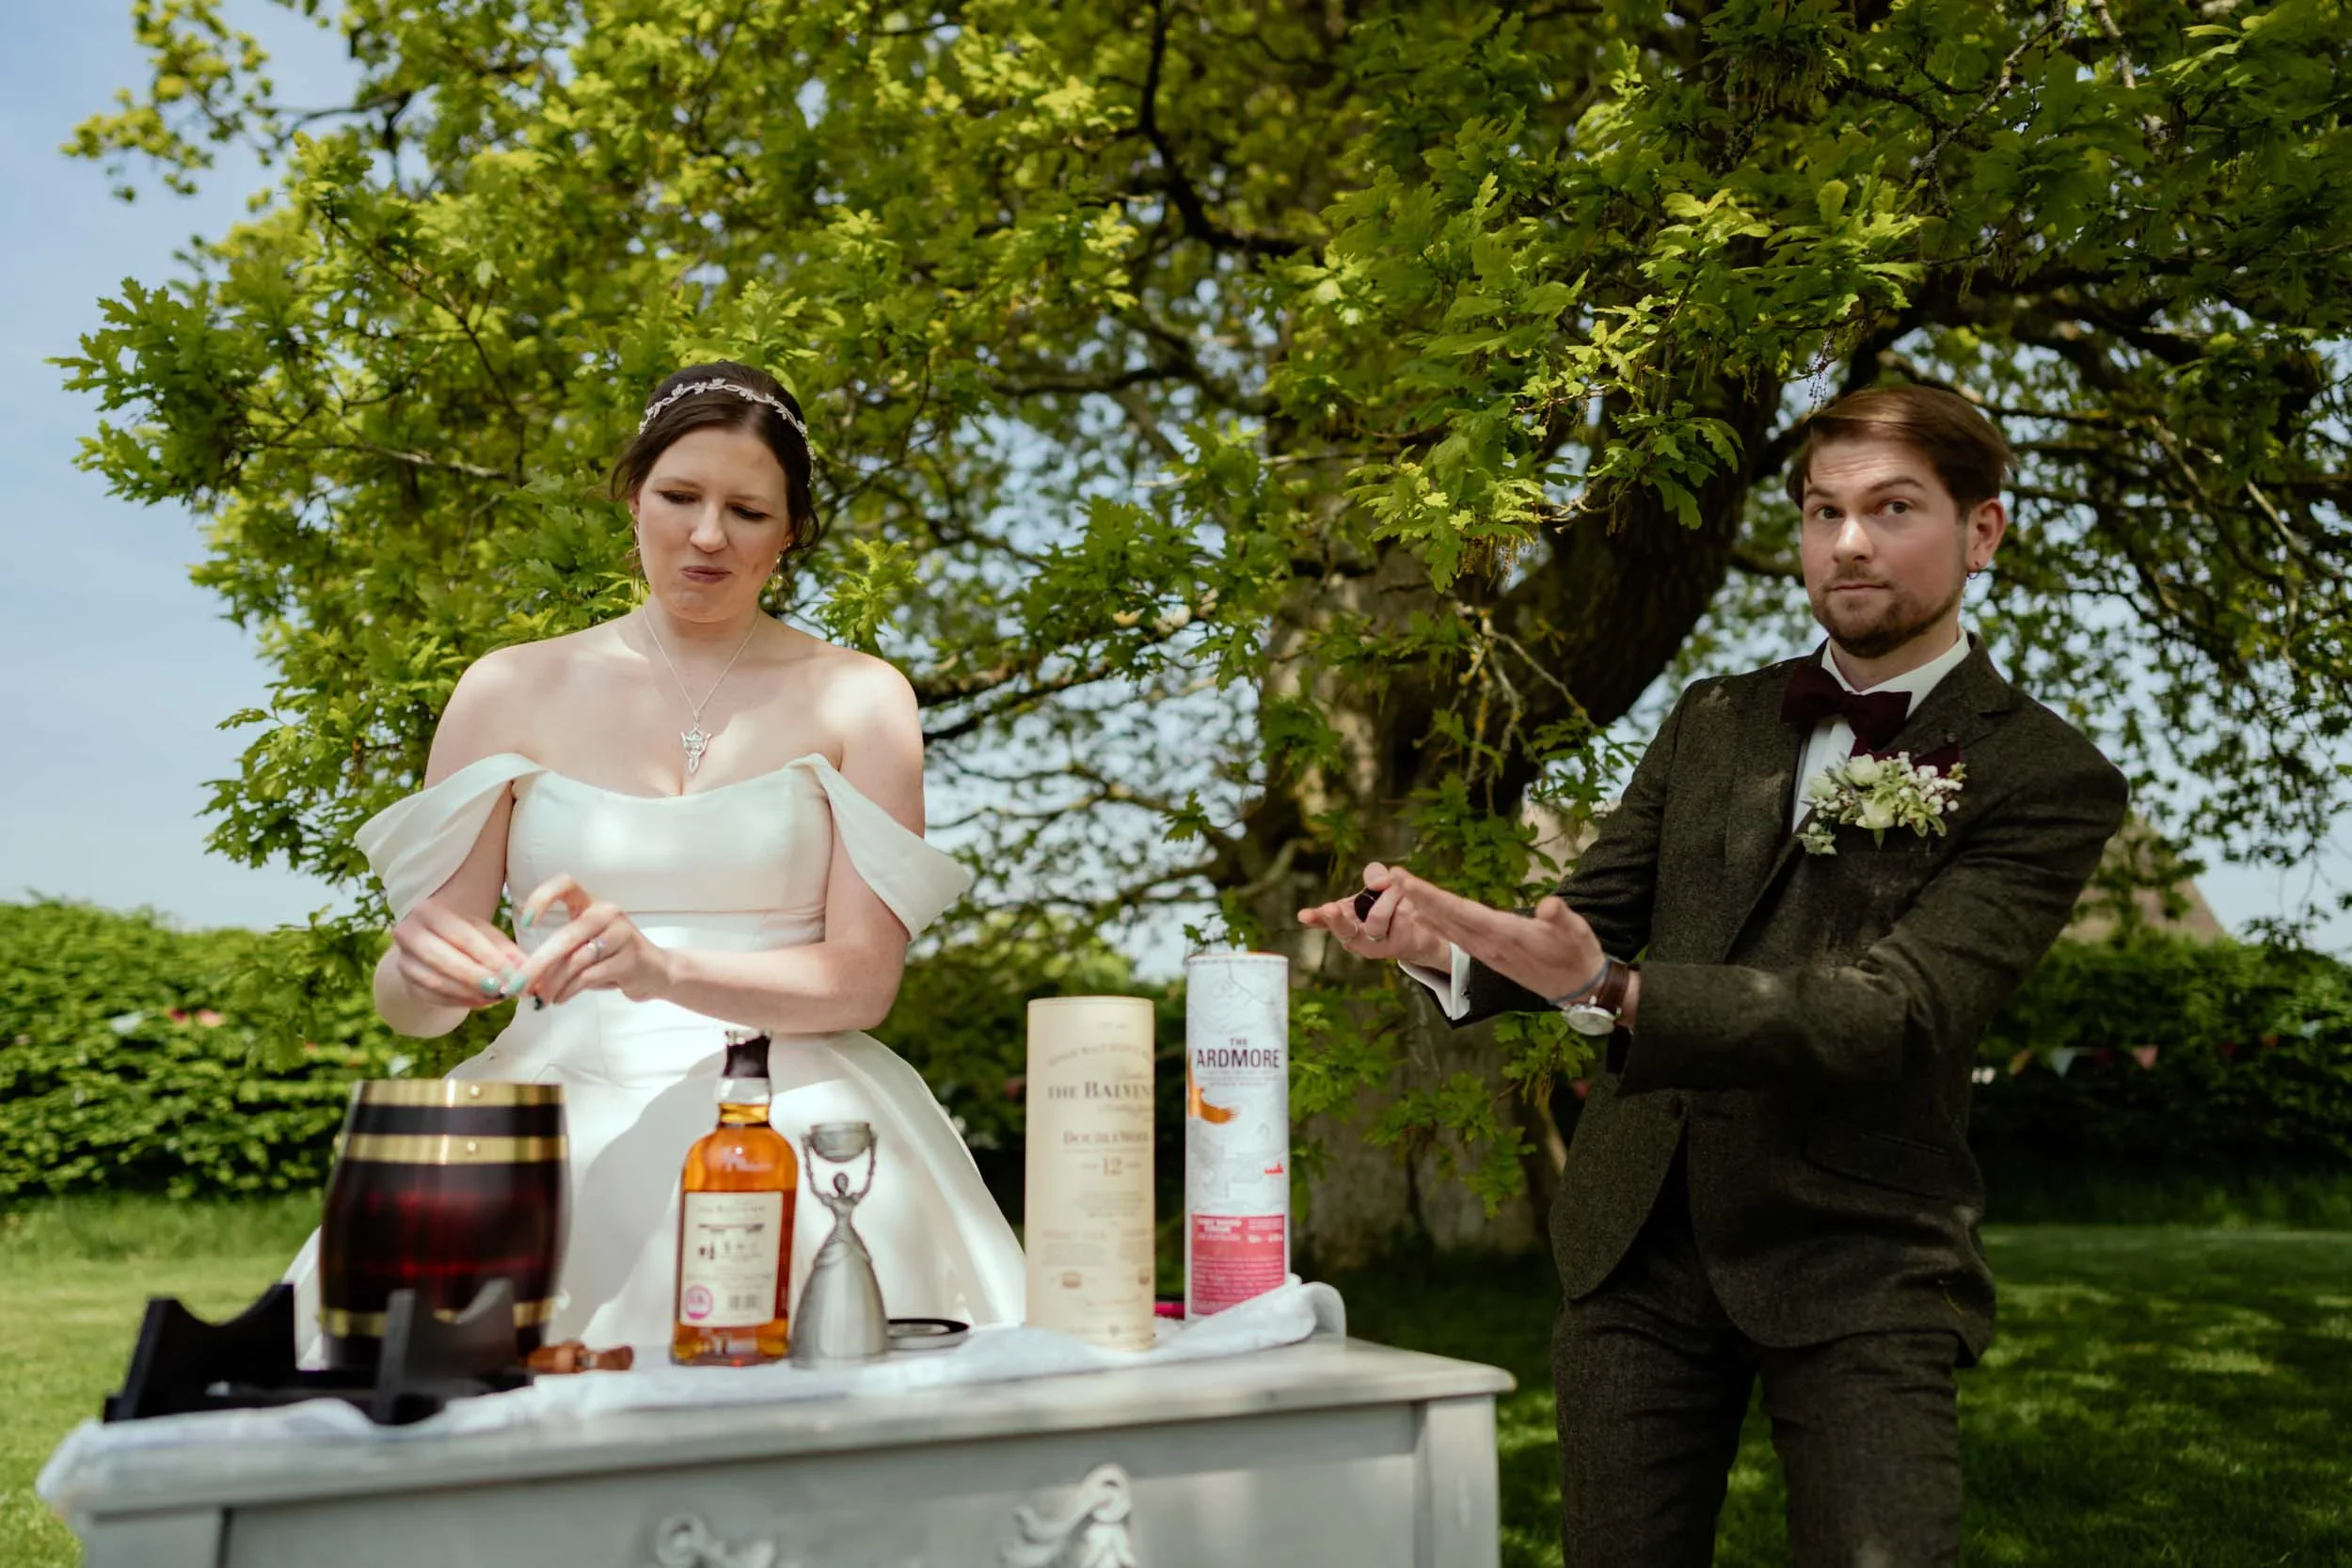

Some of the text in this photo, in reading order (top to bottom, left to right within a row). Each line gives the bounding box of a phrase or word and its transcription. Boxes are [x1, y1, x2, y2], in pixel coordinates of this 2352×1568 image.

[1230, 1037, 1248, 1046] THE
[1197, 1048, 1279, 1069] ARDMORE
[1048, 1086, 1076, 1100] THE
